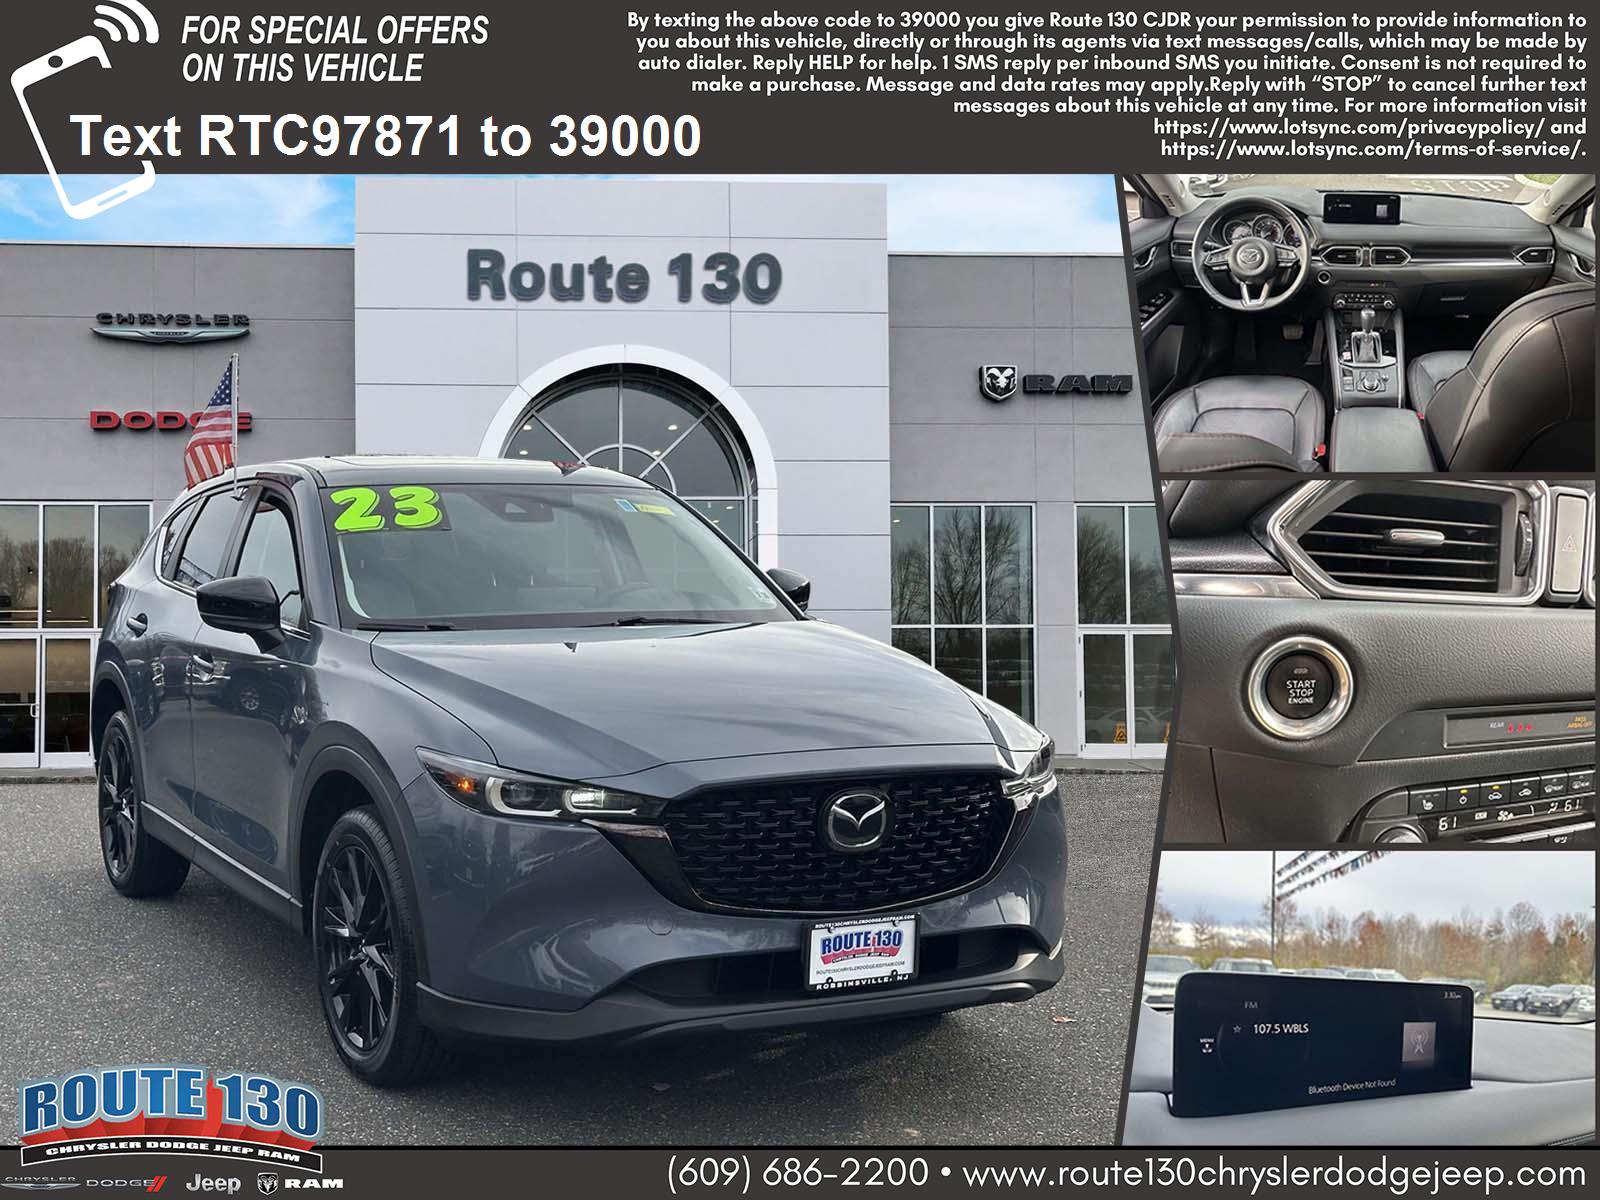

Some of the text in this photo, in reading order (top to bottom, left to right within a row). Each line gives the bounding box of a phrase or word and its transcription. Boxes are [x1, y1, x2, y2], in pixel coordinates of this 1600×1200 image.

[467, 248, 783, 304] Route 130
[96, 312, 250, 325] CHRYSLER
[1023, 374, 1133, 394] RAM
[330, 485, 443, 532] 23
[1286, 679, 1316, 689] START
[1289, 688, 1314, 697] STOP
[821, 930, 903, 955] ROUTE 130
[1244, 1001, 1258, 1009] FM
[1253, 1023, 1309, 1034] 107.5 WBLS
[1308, 1078, 1396, 1094] Bluetooth Device Not Found
